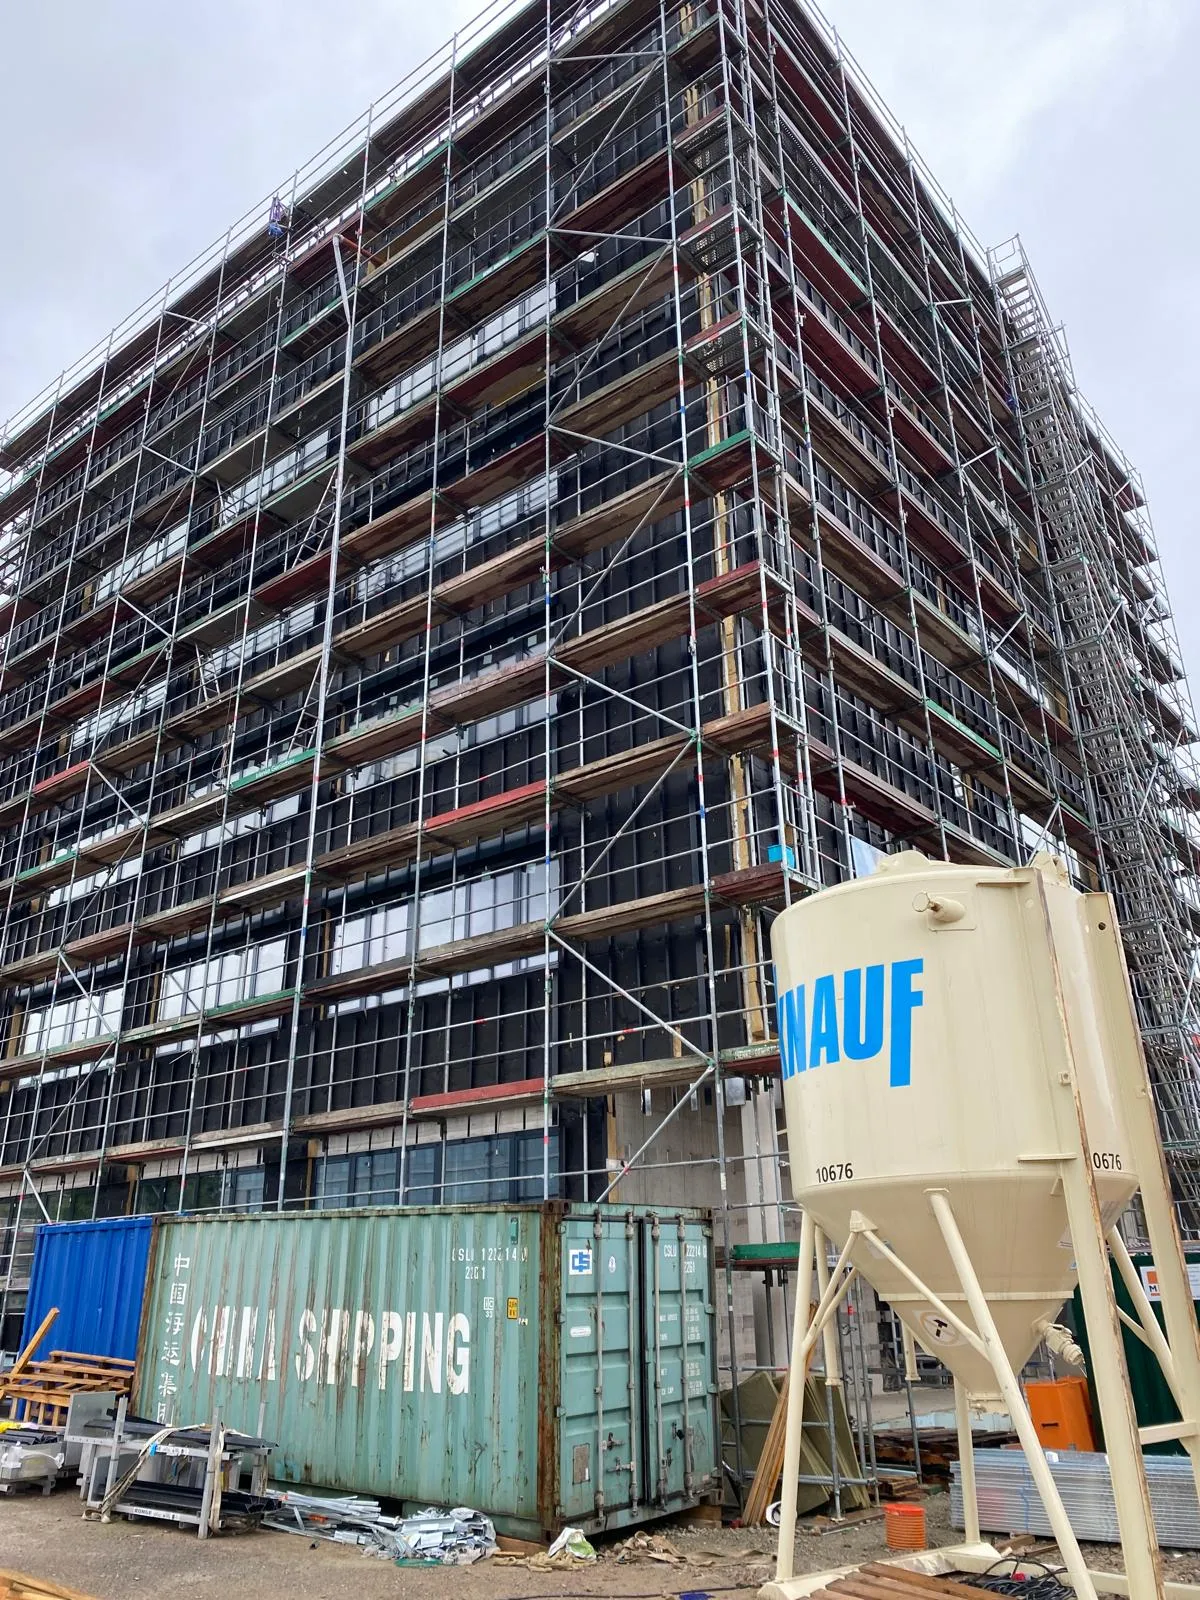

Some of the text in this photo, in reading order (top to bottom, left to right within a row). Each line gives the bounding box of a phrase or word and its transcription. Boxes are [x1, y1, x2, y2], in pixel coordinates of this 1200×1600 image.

[1093, 1152, 1122, 1170] 0676
[816, 1162, 853, 1183] 10676
[295, 1309, 470, 1396] SHIPPING
